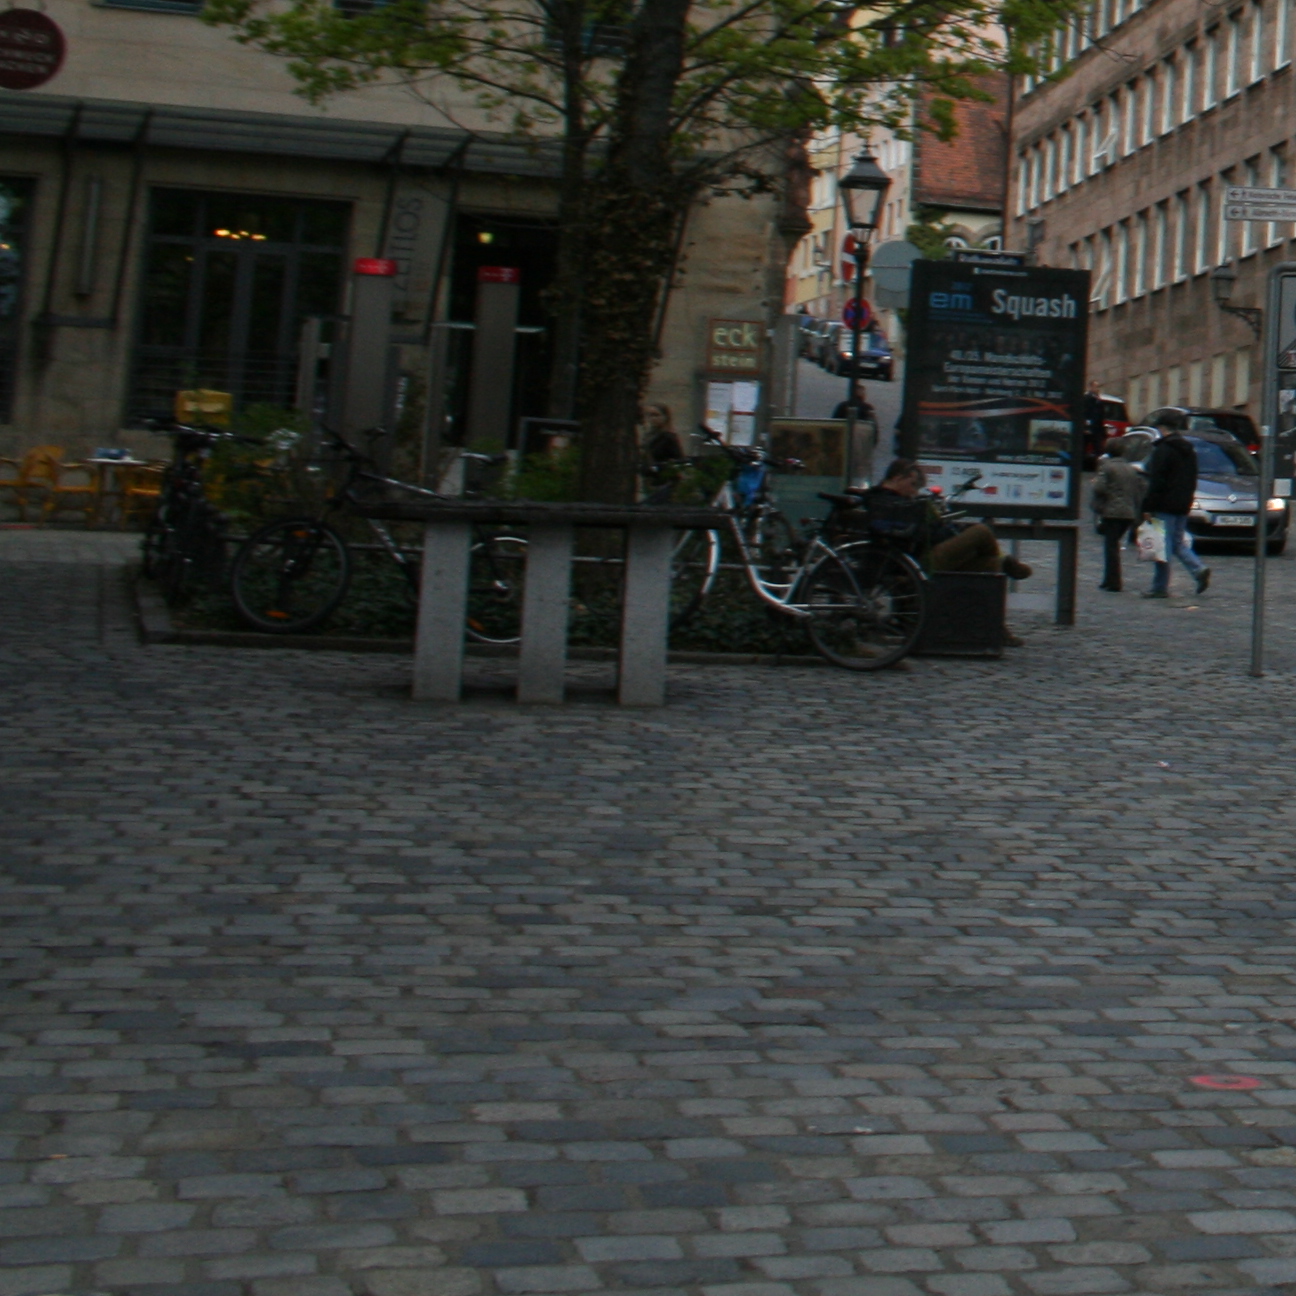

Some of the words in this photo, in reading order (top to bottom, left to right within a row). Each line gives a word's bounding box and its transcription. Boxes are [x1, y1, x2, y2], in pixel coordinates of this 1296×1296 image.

[991, 288, 1076, 320] Squash
[713, 322, 757, 347] eck
[711, 353, 757, 367] stein
